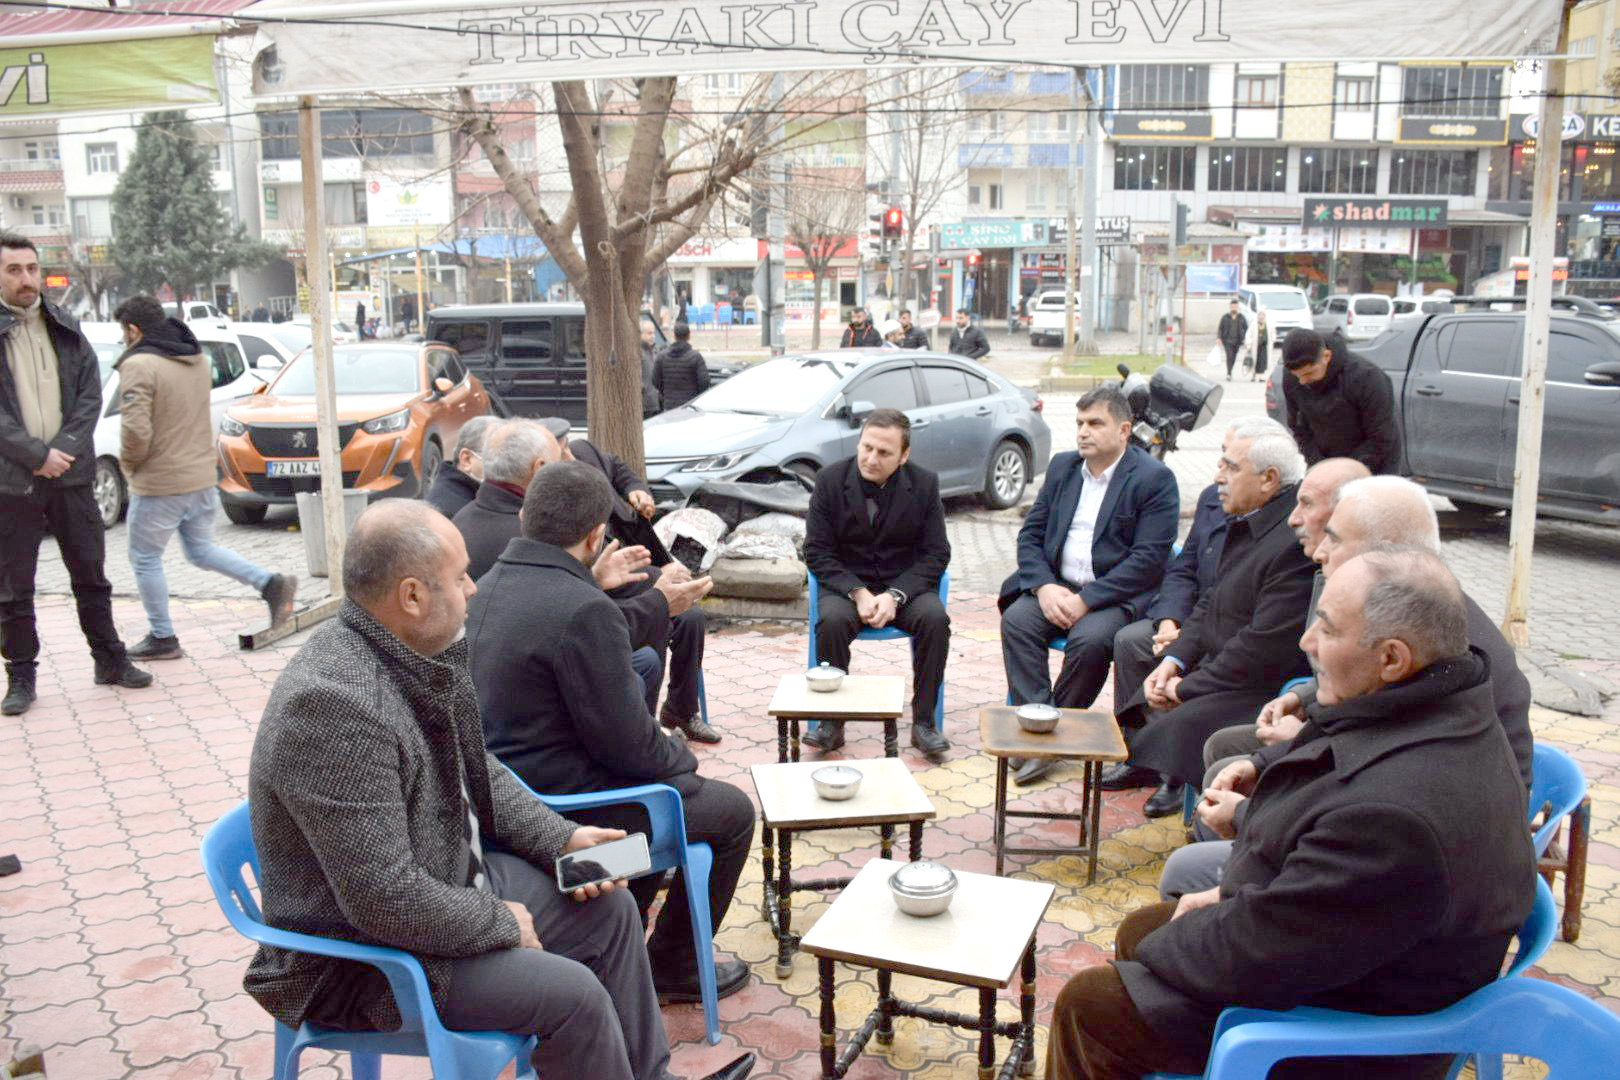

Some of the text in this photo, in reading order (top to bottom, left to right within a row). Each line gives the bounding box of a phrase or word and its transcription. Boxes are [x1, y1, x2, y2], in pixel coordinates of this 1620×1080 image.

[457, 0, 819, 66] TİRYAKİ
[840, 0, 1031, 65] ÇAY
[1333, 202, 1442, 222] shadmar
[675, 245, 712, 256] OSCH
[273, 462, 321, 474] 72 AAZ 4
